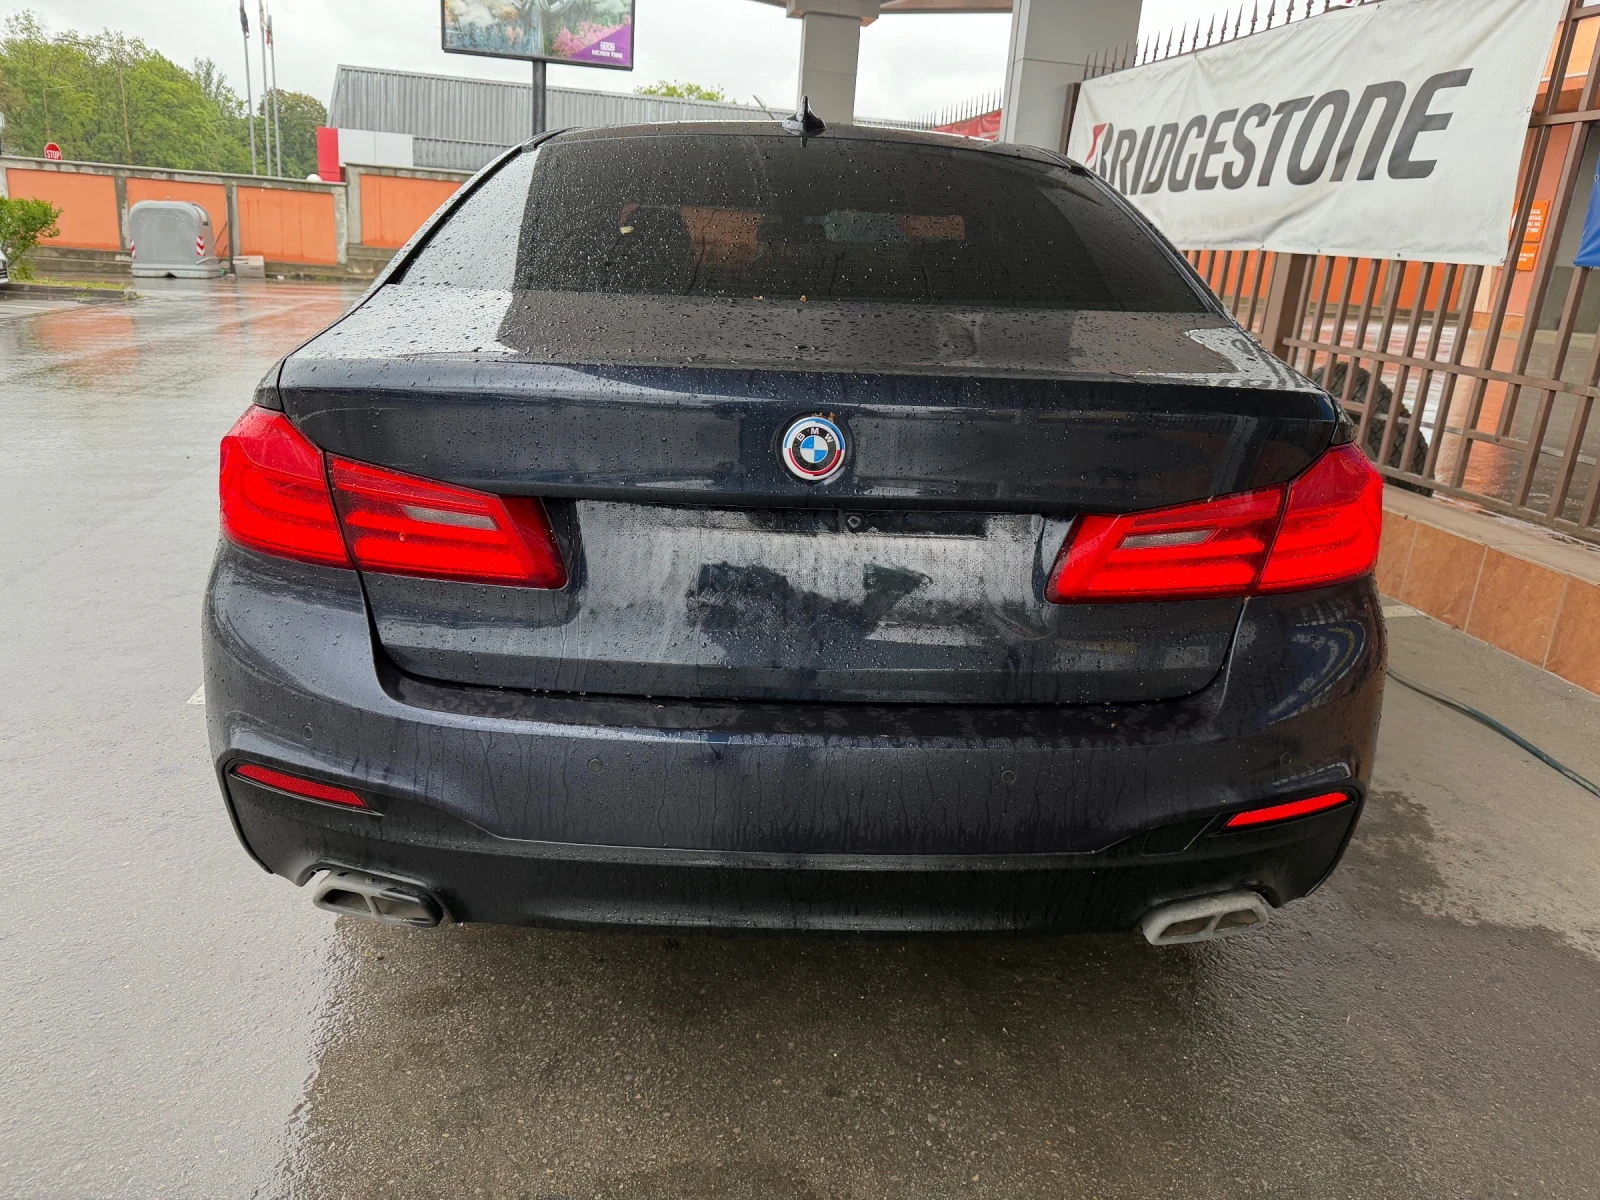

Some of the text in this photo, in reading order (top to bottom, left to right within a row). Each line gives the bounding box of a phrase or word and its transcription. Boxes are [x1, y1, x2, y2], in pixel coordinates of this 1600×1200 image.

[1085, 67, 1473, 196] BRIDGESTONE
[46, 149, 60, 159] STOP
[796, 427, 834, 443] BMW
